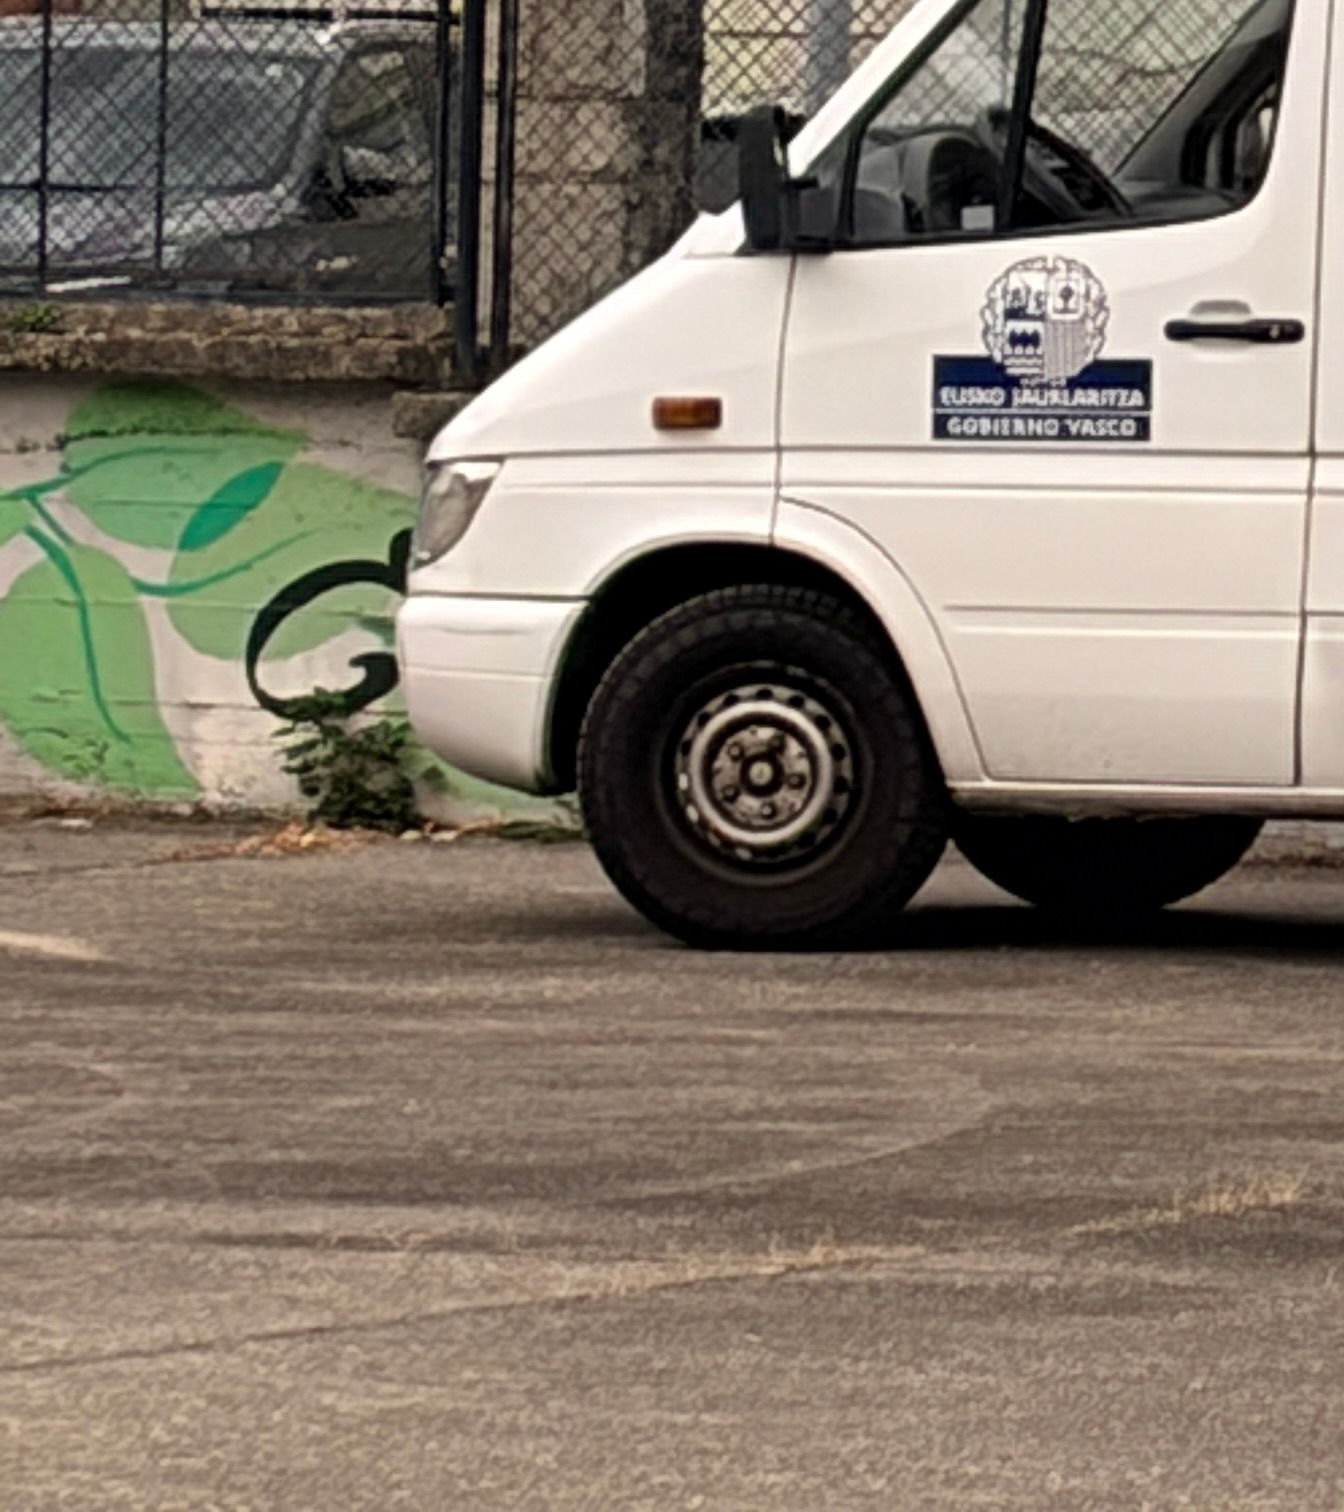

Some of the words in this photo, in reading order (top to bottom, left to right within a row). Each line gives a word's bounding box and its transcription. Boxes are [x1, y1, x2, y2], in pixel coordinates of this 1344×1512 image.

[940, 386, 1005, 406] EUSKO
[946, 416, 1060, 436] GOBIERNO
[1066, 418, 1138, 437] VASCO
